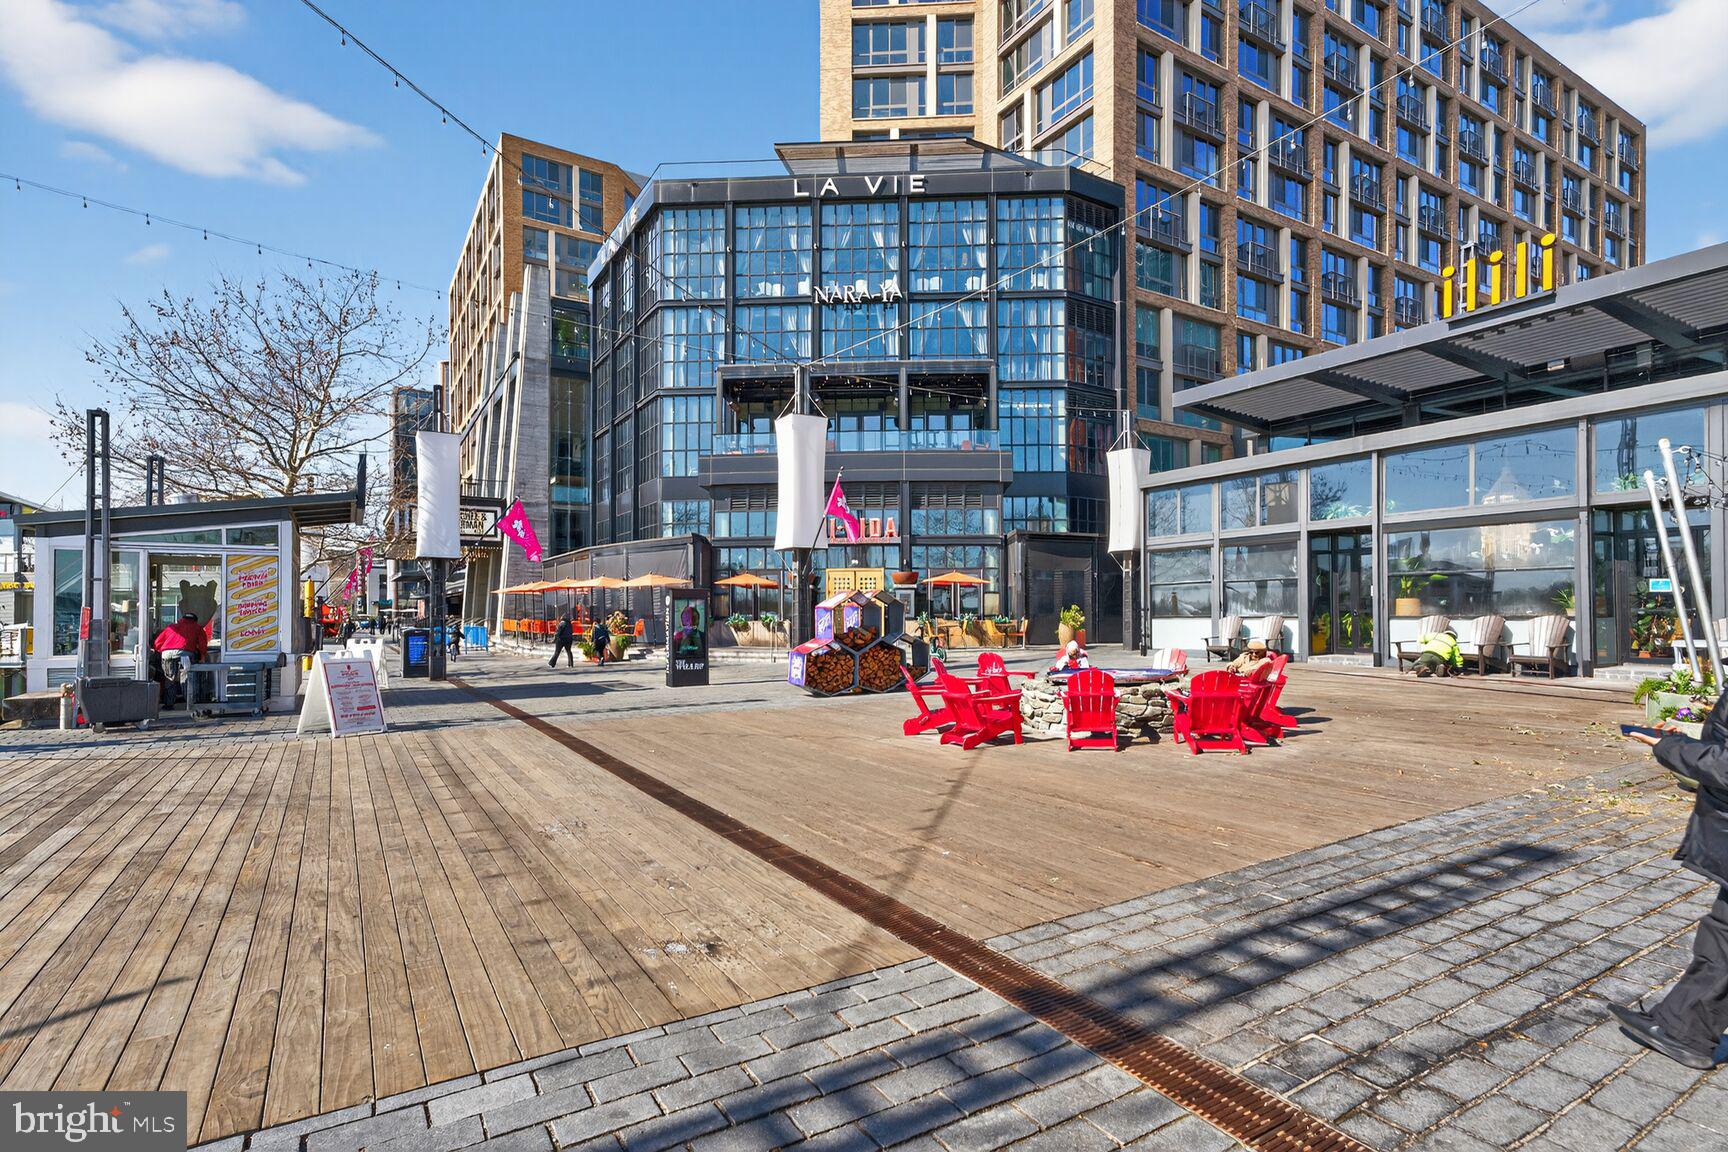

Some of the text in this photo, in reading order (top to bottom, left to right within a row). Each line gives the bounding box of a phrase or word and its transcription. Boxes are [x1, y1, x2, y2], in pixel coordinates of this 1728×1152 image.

[793, 175, 925, 197] LA VIE
[1442, 233, 1556, 319] ilili
[813, 275, 903, 304] NARA-YA
[859, 516, 898, 539] IDA
